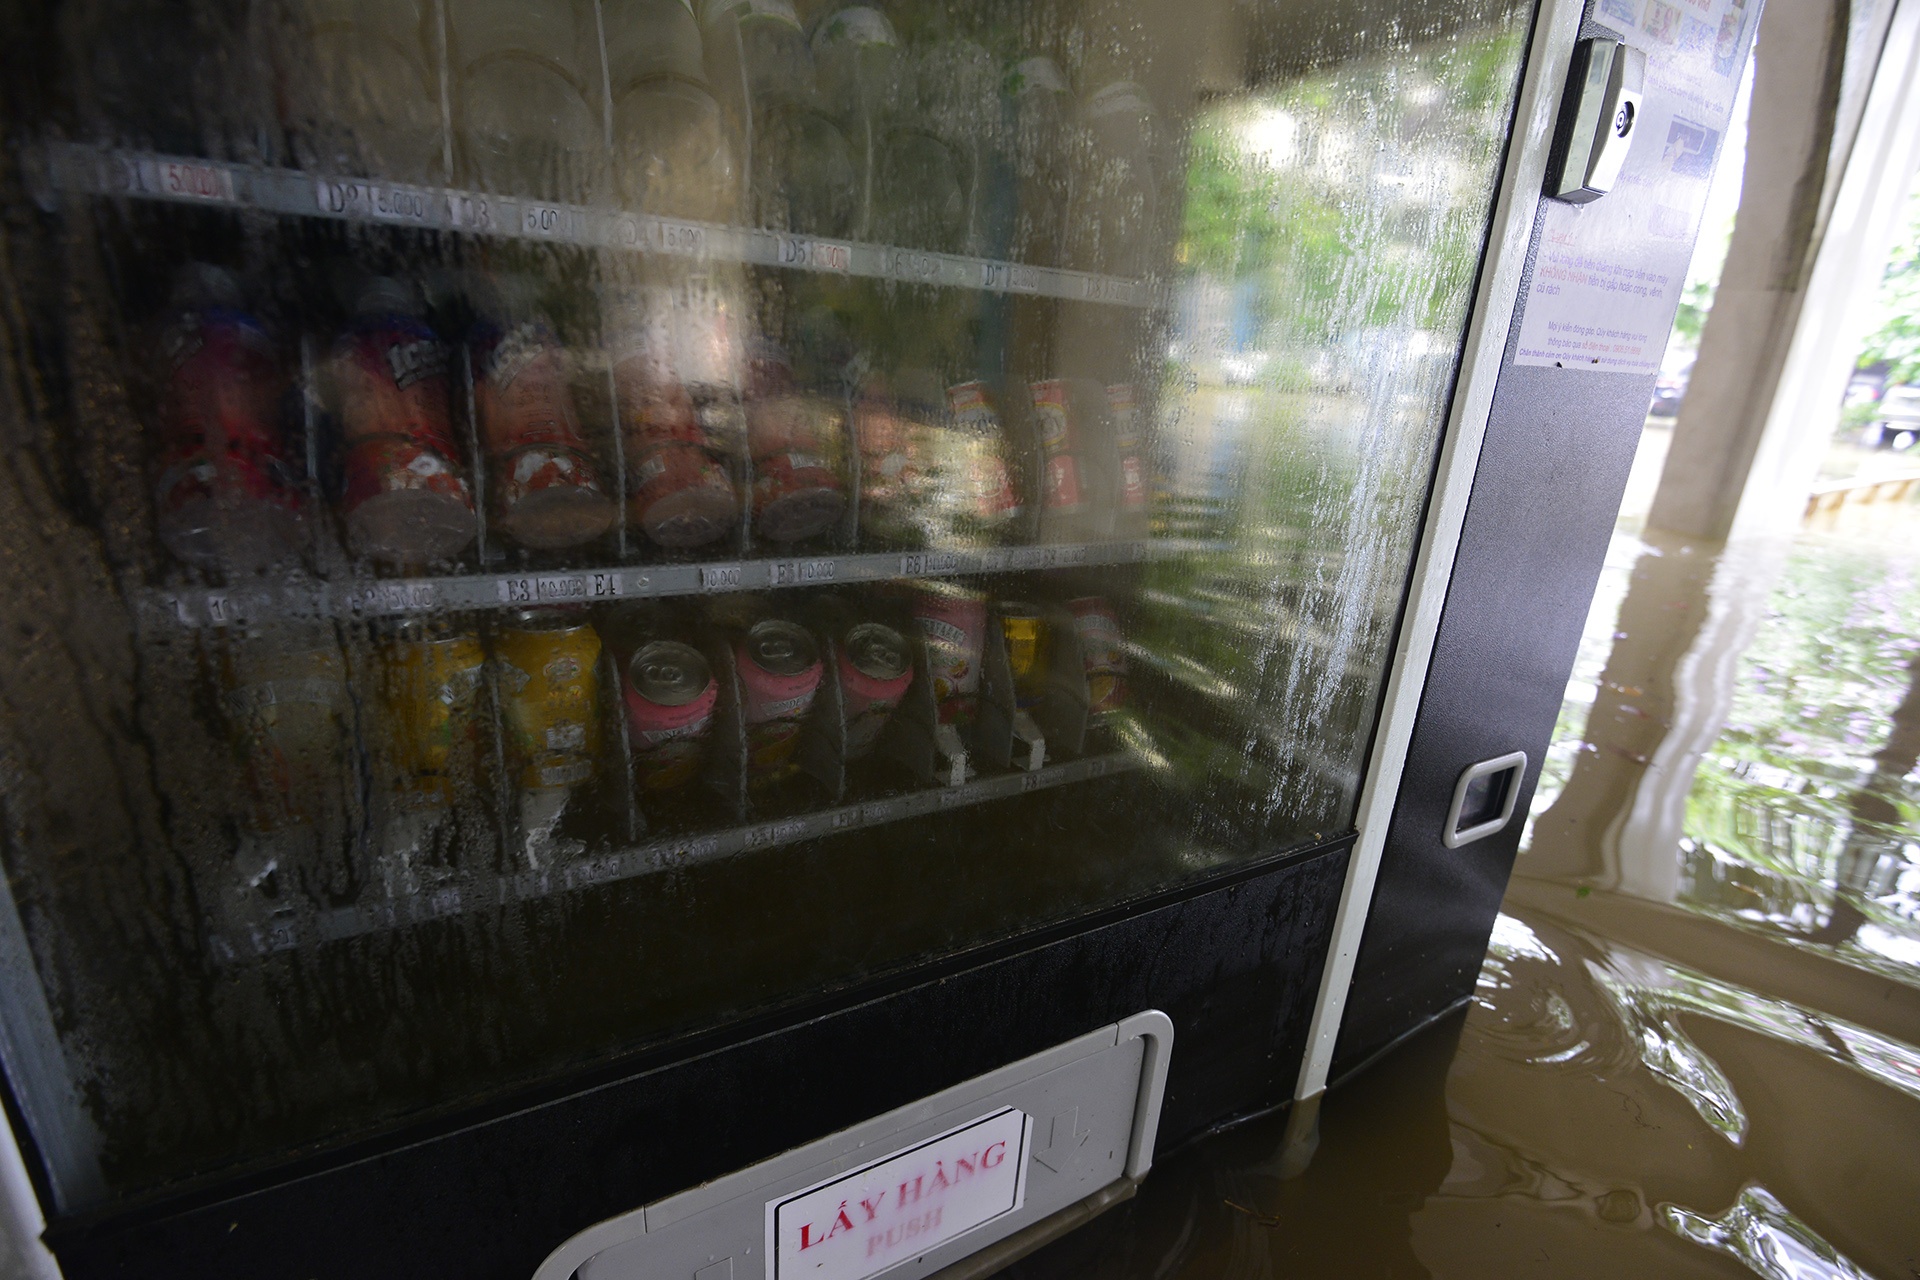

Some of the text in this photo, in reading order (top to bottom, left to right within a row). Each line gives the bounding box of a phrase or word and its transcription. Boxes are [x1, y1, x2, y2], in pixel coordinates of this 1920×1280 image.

[784, 239, 806, 263] D5
[1540, 265, 1567, 281] KHÔNG
[906, 555, 921, 574] E6
[507, 580, 530, 601] E3
[595, 574, 616, 596] E4
[798, 1141, 1006, 1252] LẤY HÀNG
[866, 1205, 945, 1258] PUSH
